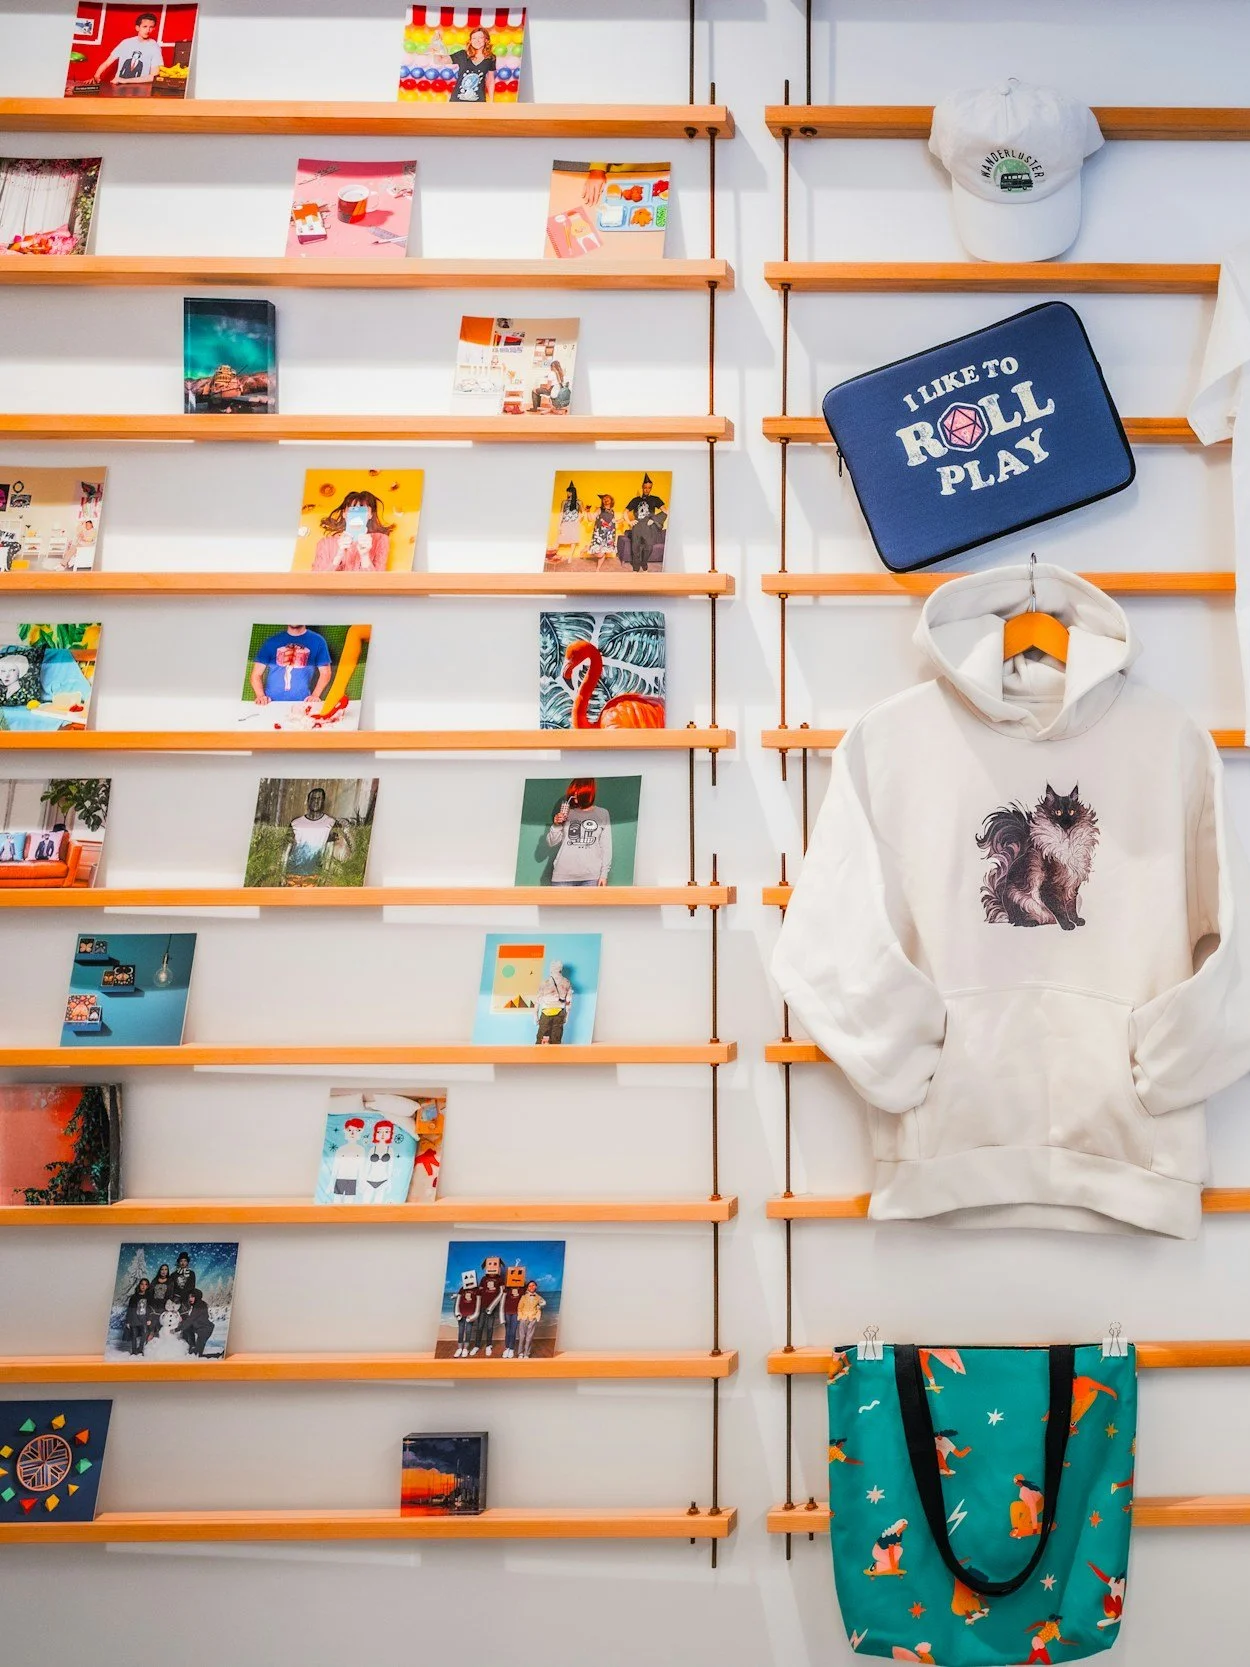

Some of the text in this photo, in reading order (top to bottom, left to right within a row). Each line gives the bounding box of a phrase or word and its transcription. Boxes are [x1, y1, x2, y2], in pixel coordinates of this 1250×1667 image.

[981, 149, 1045, 178] WANDERLUSTER
[903, 356, 1019, 412] I LIKE TO
[895, 380, 1055, 467] ROLL
[936, 427, 1050, 496] PLAY
